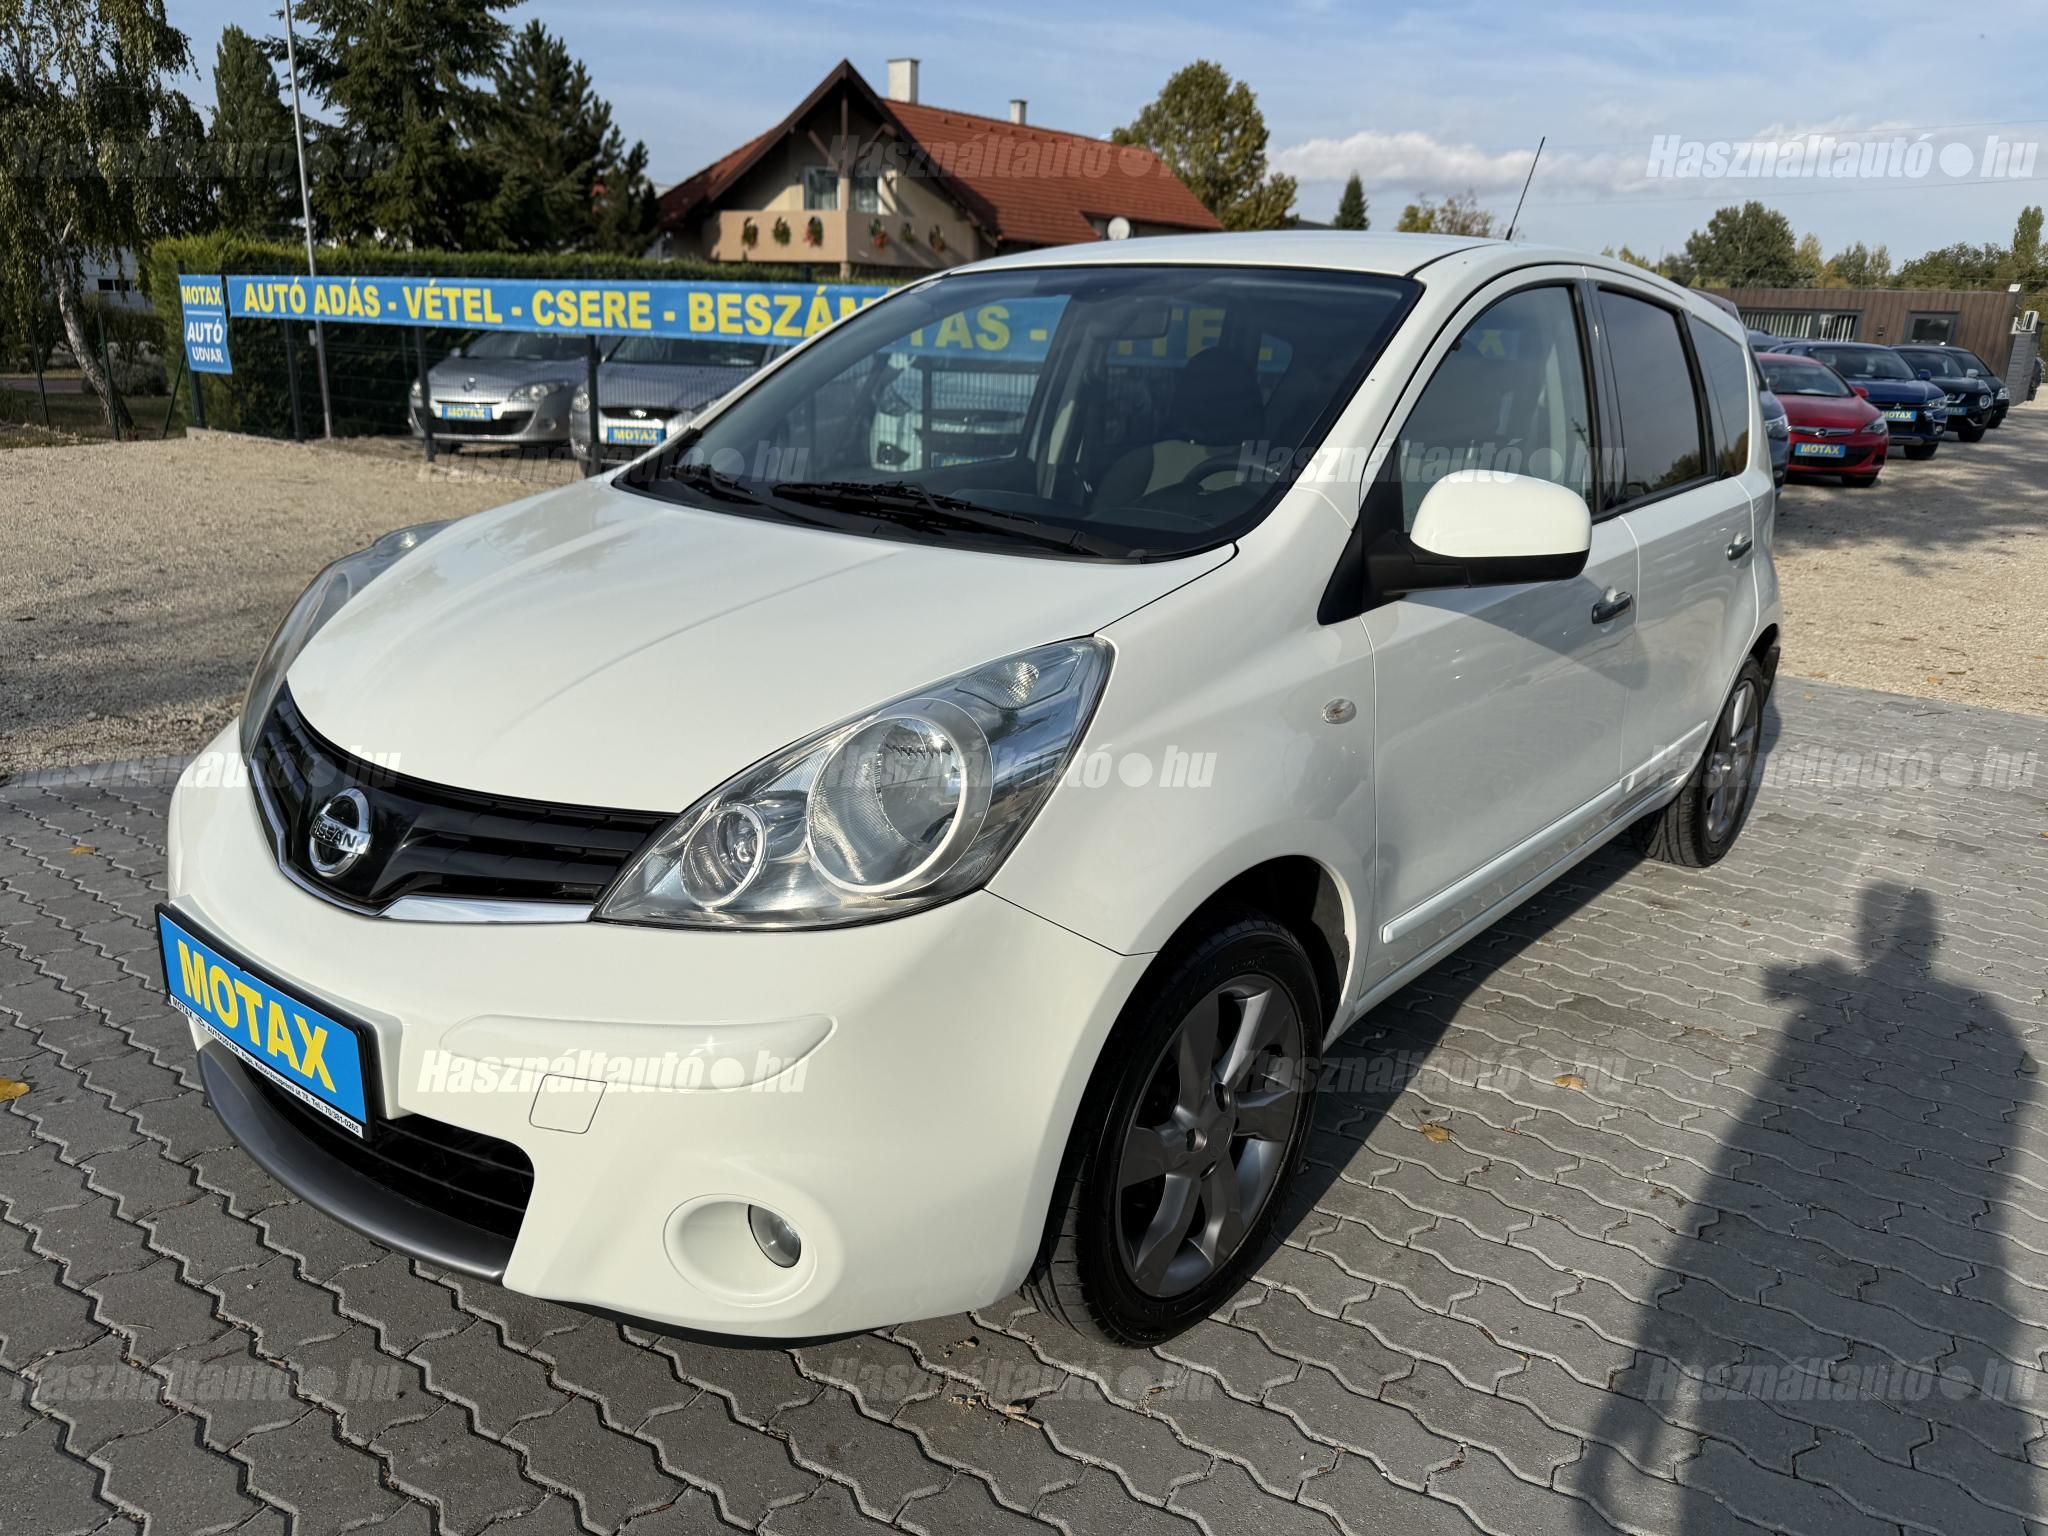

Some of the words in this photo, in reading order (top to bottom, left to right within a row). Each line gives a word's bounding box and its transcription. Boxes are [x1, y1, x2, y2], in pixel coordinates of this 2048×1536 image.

[181, 286, 222, 305] MOTAX
[244, 277, 306, 314] AUTÓ
[314, 279, 380, 317] ADÁS
[403, 279, 502, 323] VÉTEL
[532, 289, 652, 329] CSERE
[187, 318, 223, 344] AUTÓ
[192, 347, 224, 363] UDVAR
[1881, 411, 1912, 419] MOTAX
[614, 430, 657, 441] MOTAX
[1800, 443, 1840, 455] MOTAX
[313, 820, 358, 848] ISSAN
[178, 939, 337, 1093] MOTAX
